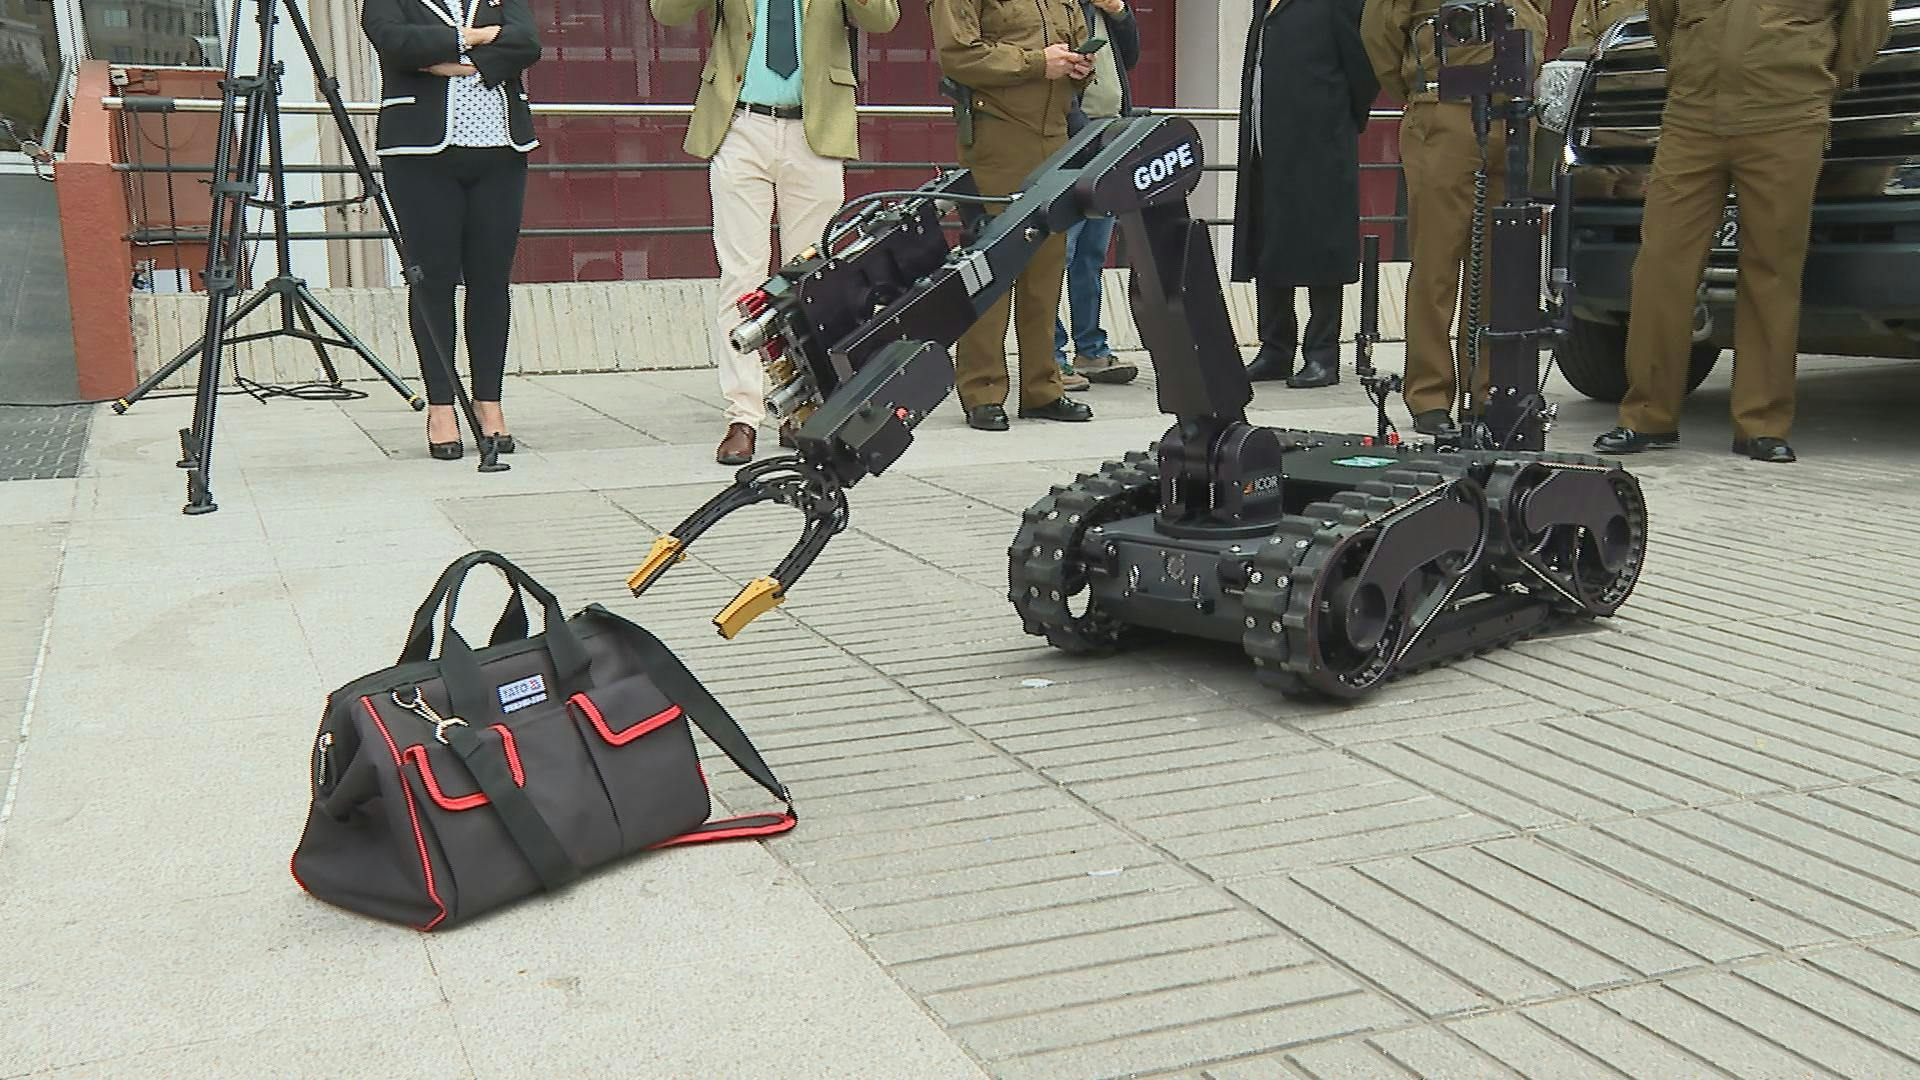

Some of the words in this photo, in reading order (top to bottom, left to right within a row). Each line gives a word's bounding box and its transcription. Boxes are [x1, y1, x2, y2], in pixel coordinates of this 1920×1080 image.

[1133, 142, 1194, 190] GOPE
[1254, 475, 1278, 491] ICOR
[503, 682, 529, 699] YATO
